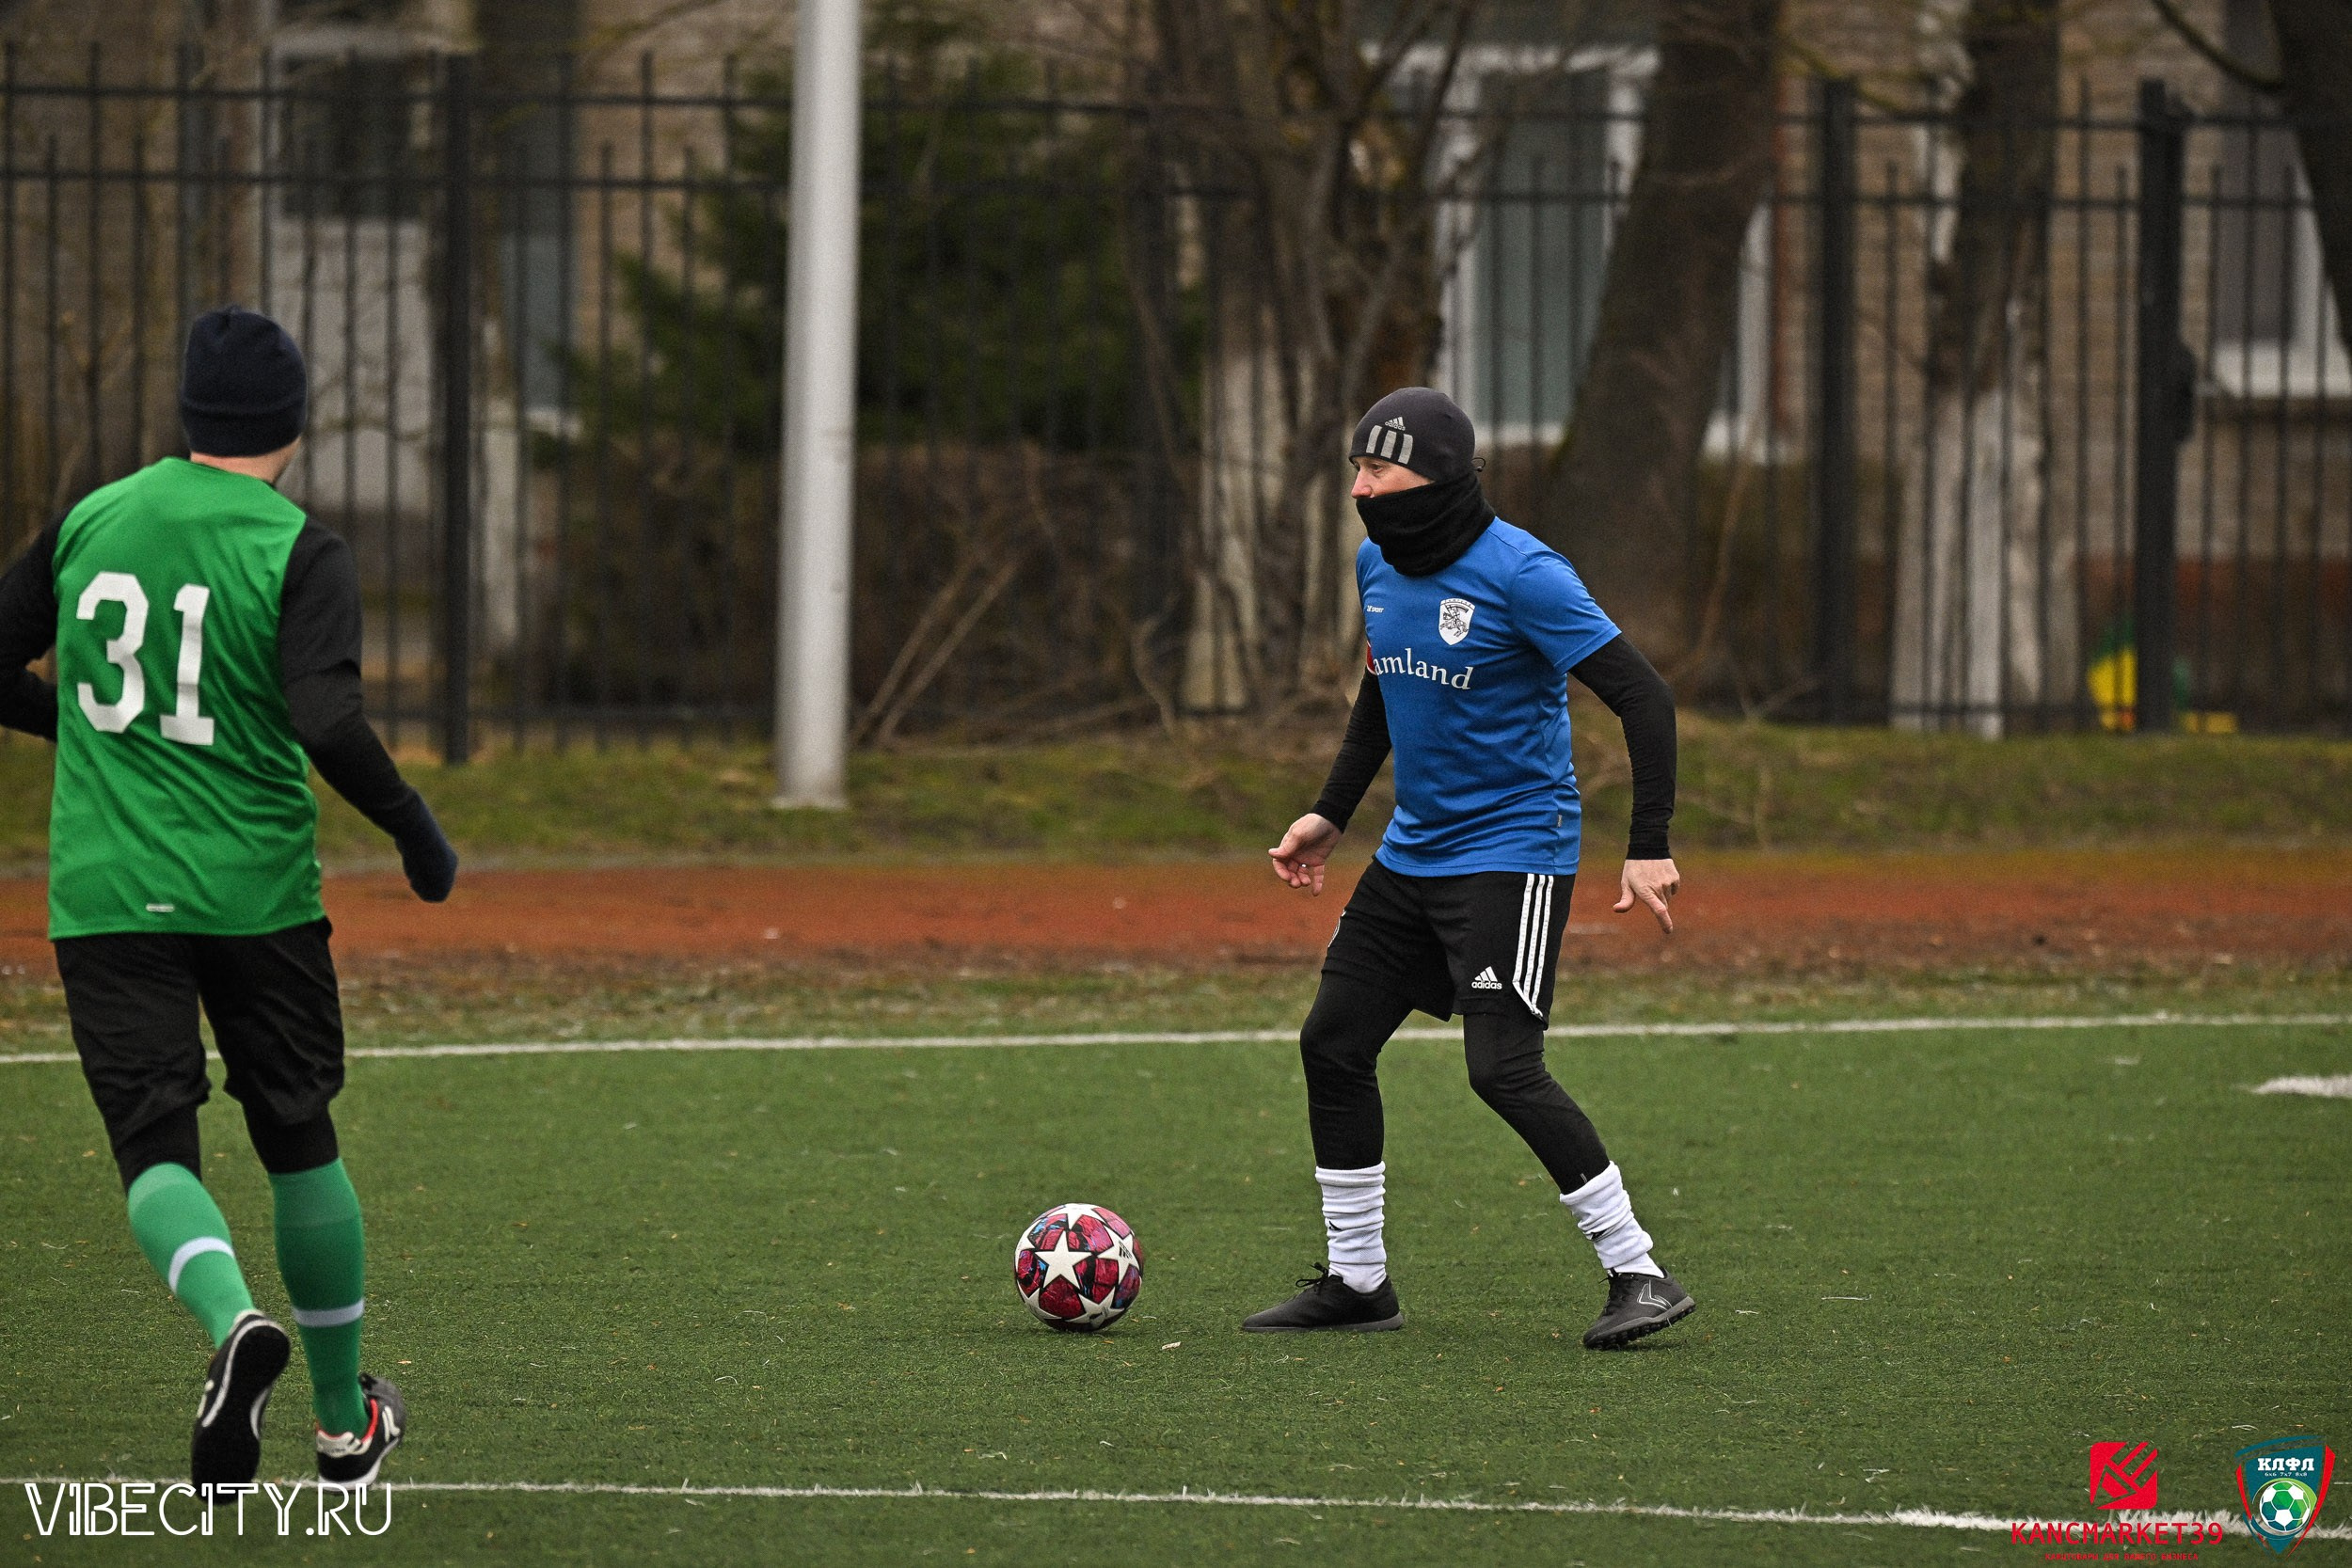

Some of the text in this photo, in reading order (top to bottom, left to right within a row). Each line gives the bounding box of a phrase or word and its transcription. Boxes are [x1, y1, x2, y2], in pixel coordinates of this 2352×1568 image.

[76, 571, 215, 746] 31
[1367, 641, 1474, 690] amland
[1471, 979, 1502, 990] adidas
